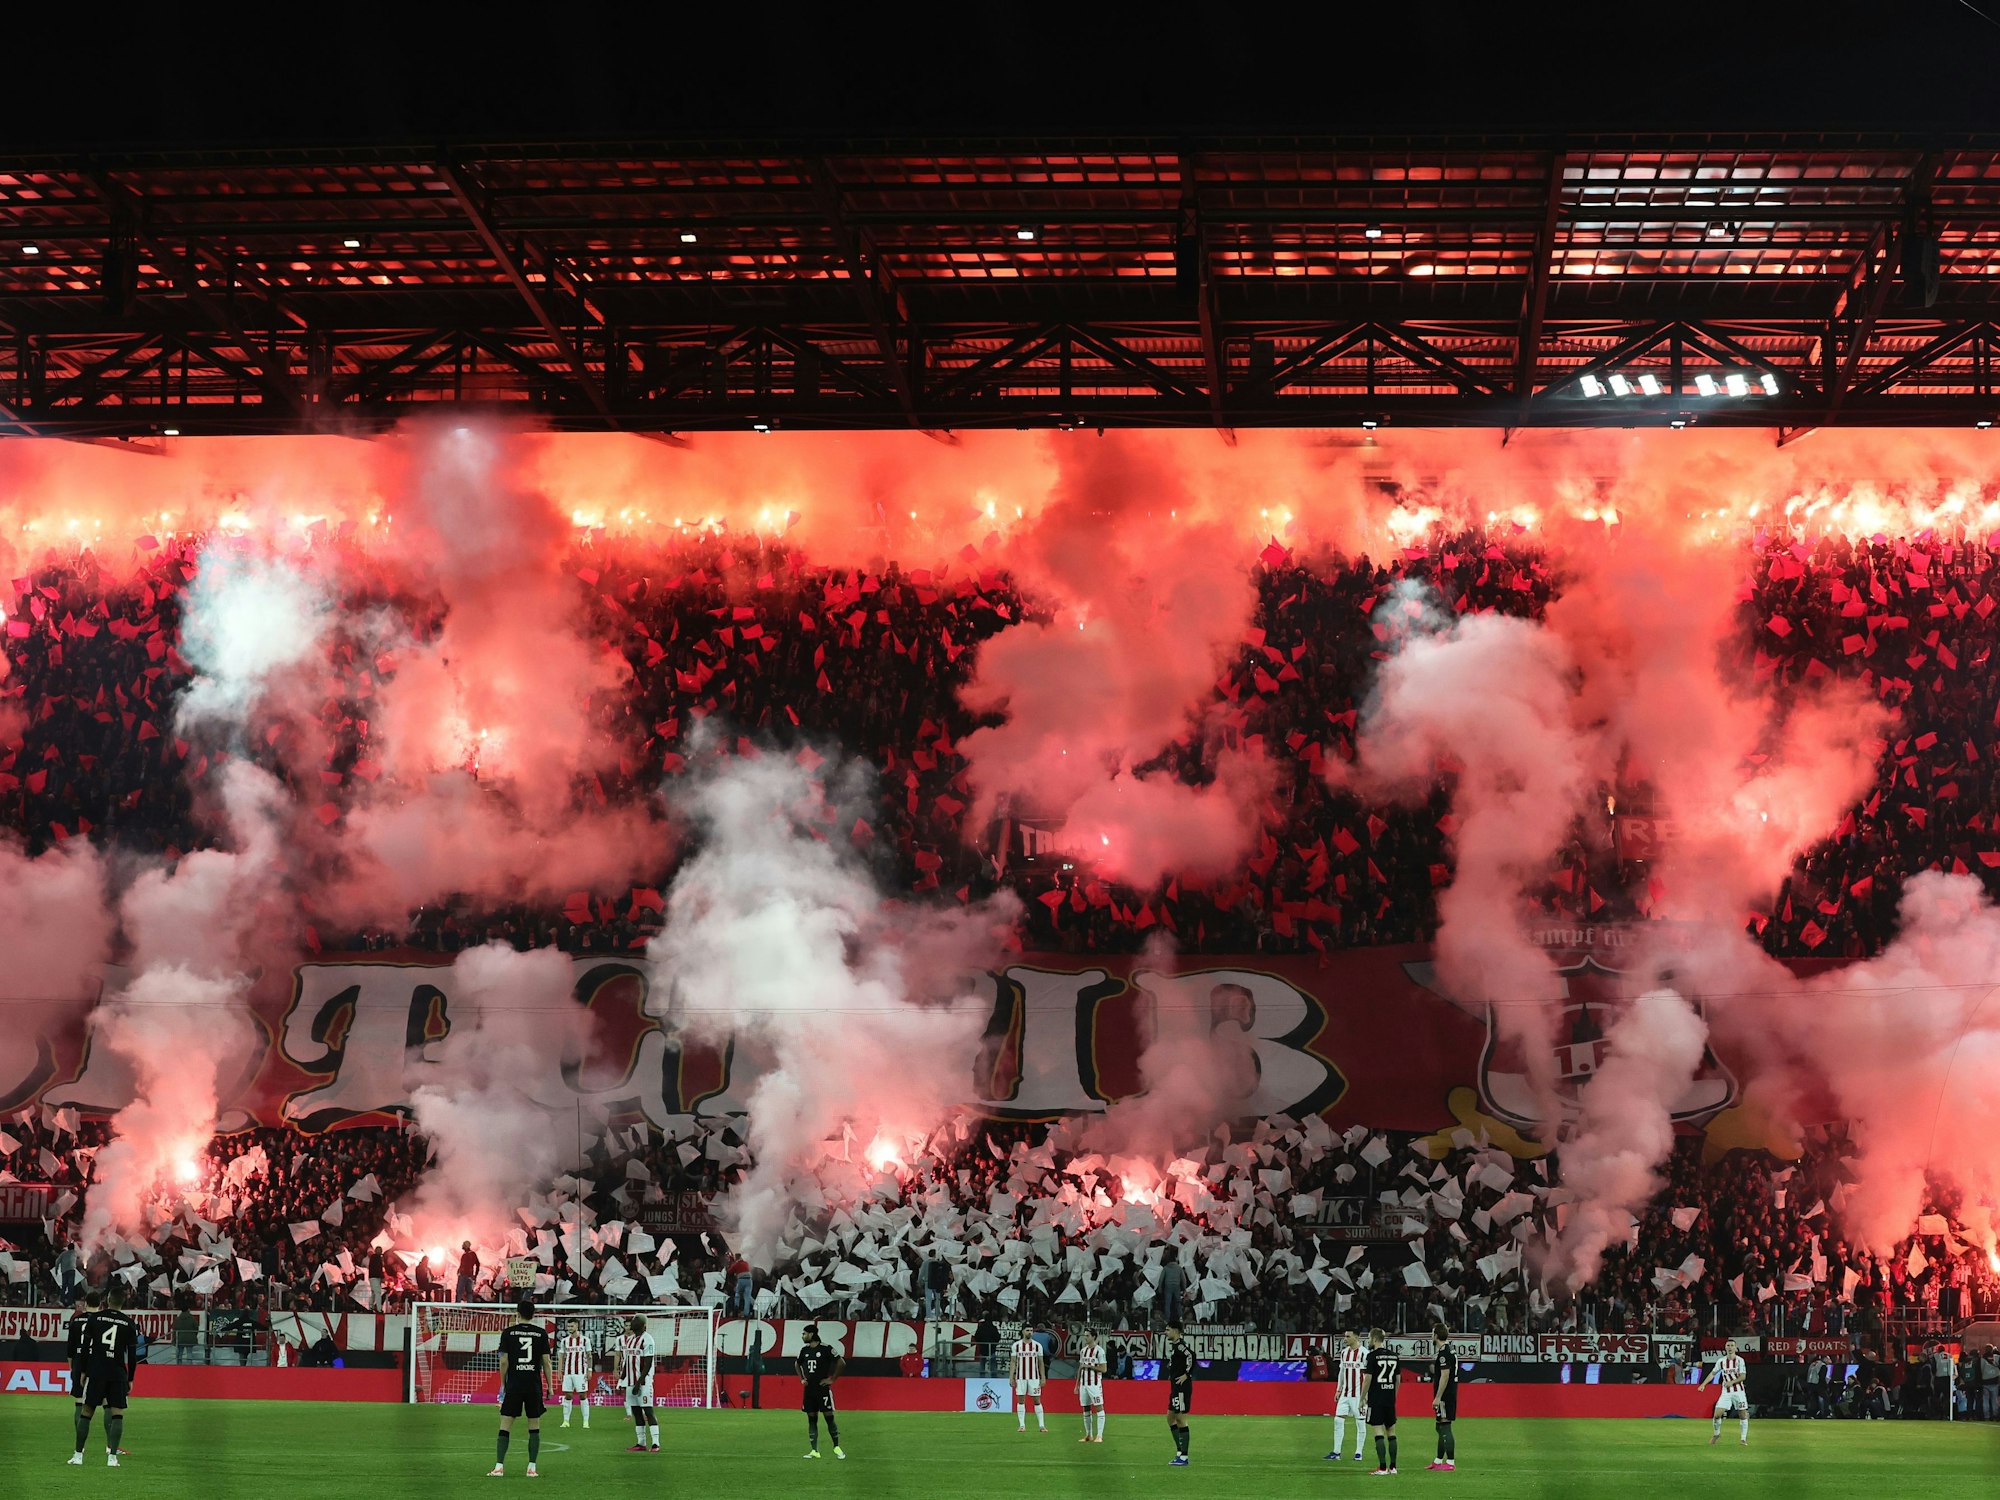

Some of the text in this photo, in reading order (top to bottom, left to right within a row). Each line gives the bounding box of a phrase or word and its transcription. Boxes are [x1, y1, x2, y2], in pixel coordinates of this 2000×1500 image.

[642, 1211, 674, 1223] JUNGS
[101, 1324, 118, 1351] 4
[1483, 1334, 1535, 1354] RAFIKIS
[1539, 1335, 1648, 1354] FREAKS
[1767, 1341, 1790, 1351] RED
[1808, 1340, 1848, 1351] GOATS
[518, 1336, 532, 1363] 3
[1154, 1334, 1282, 1361] VEDELSRADAU
[1540, 1353, 1647, 1363] COLOGNE
[1377, 1360, 1397, 1383] 27
[822, 1396, 829, 1406] 7
